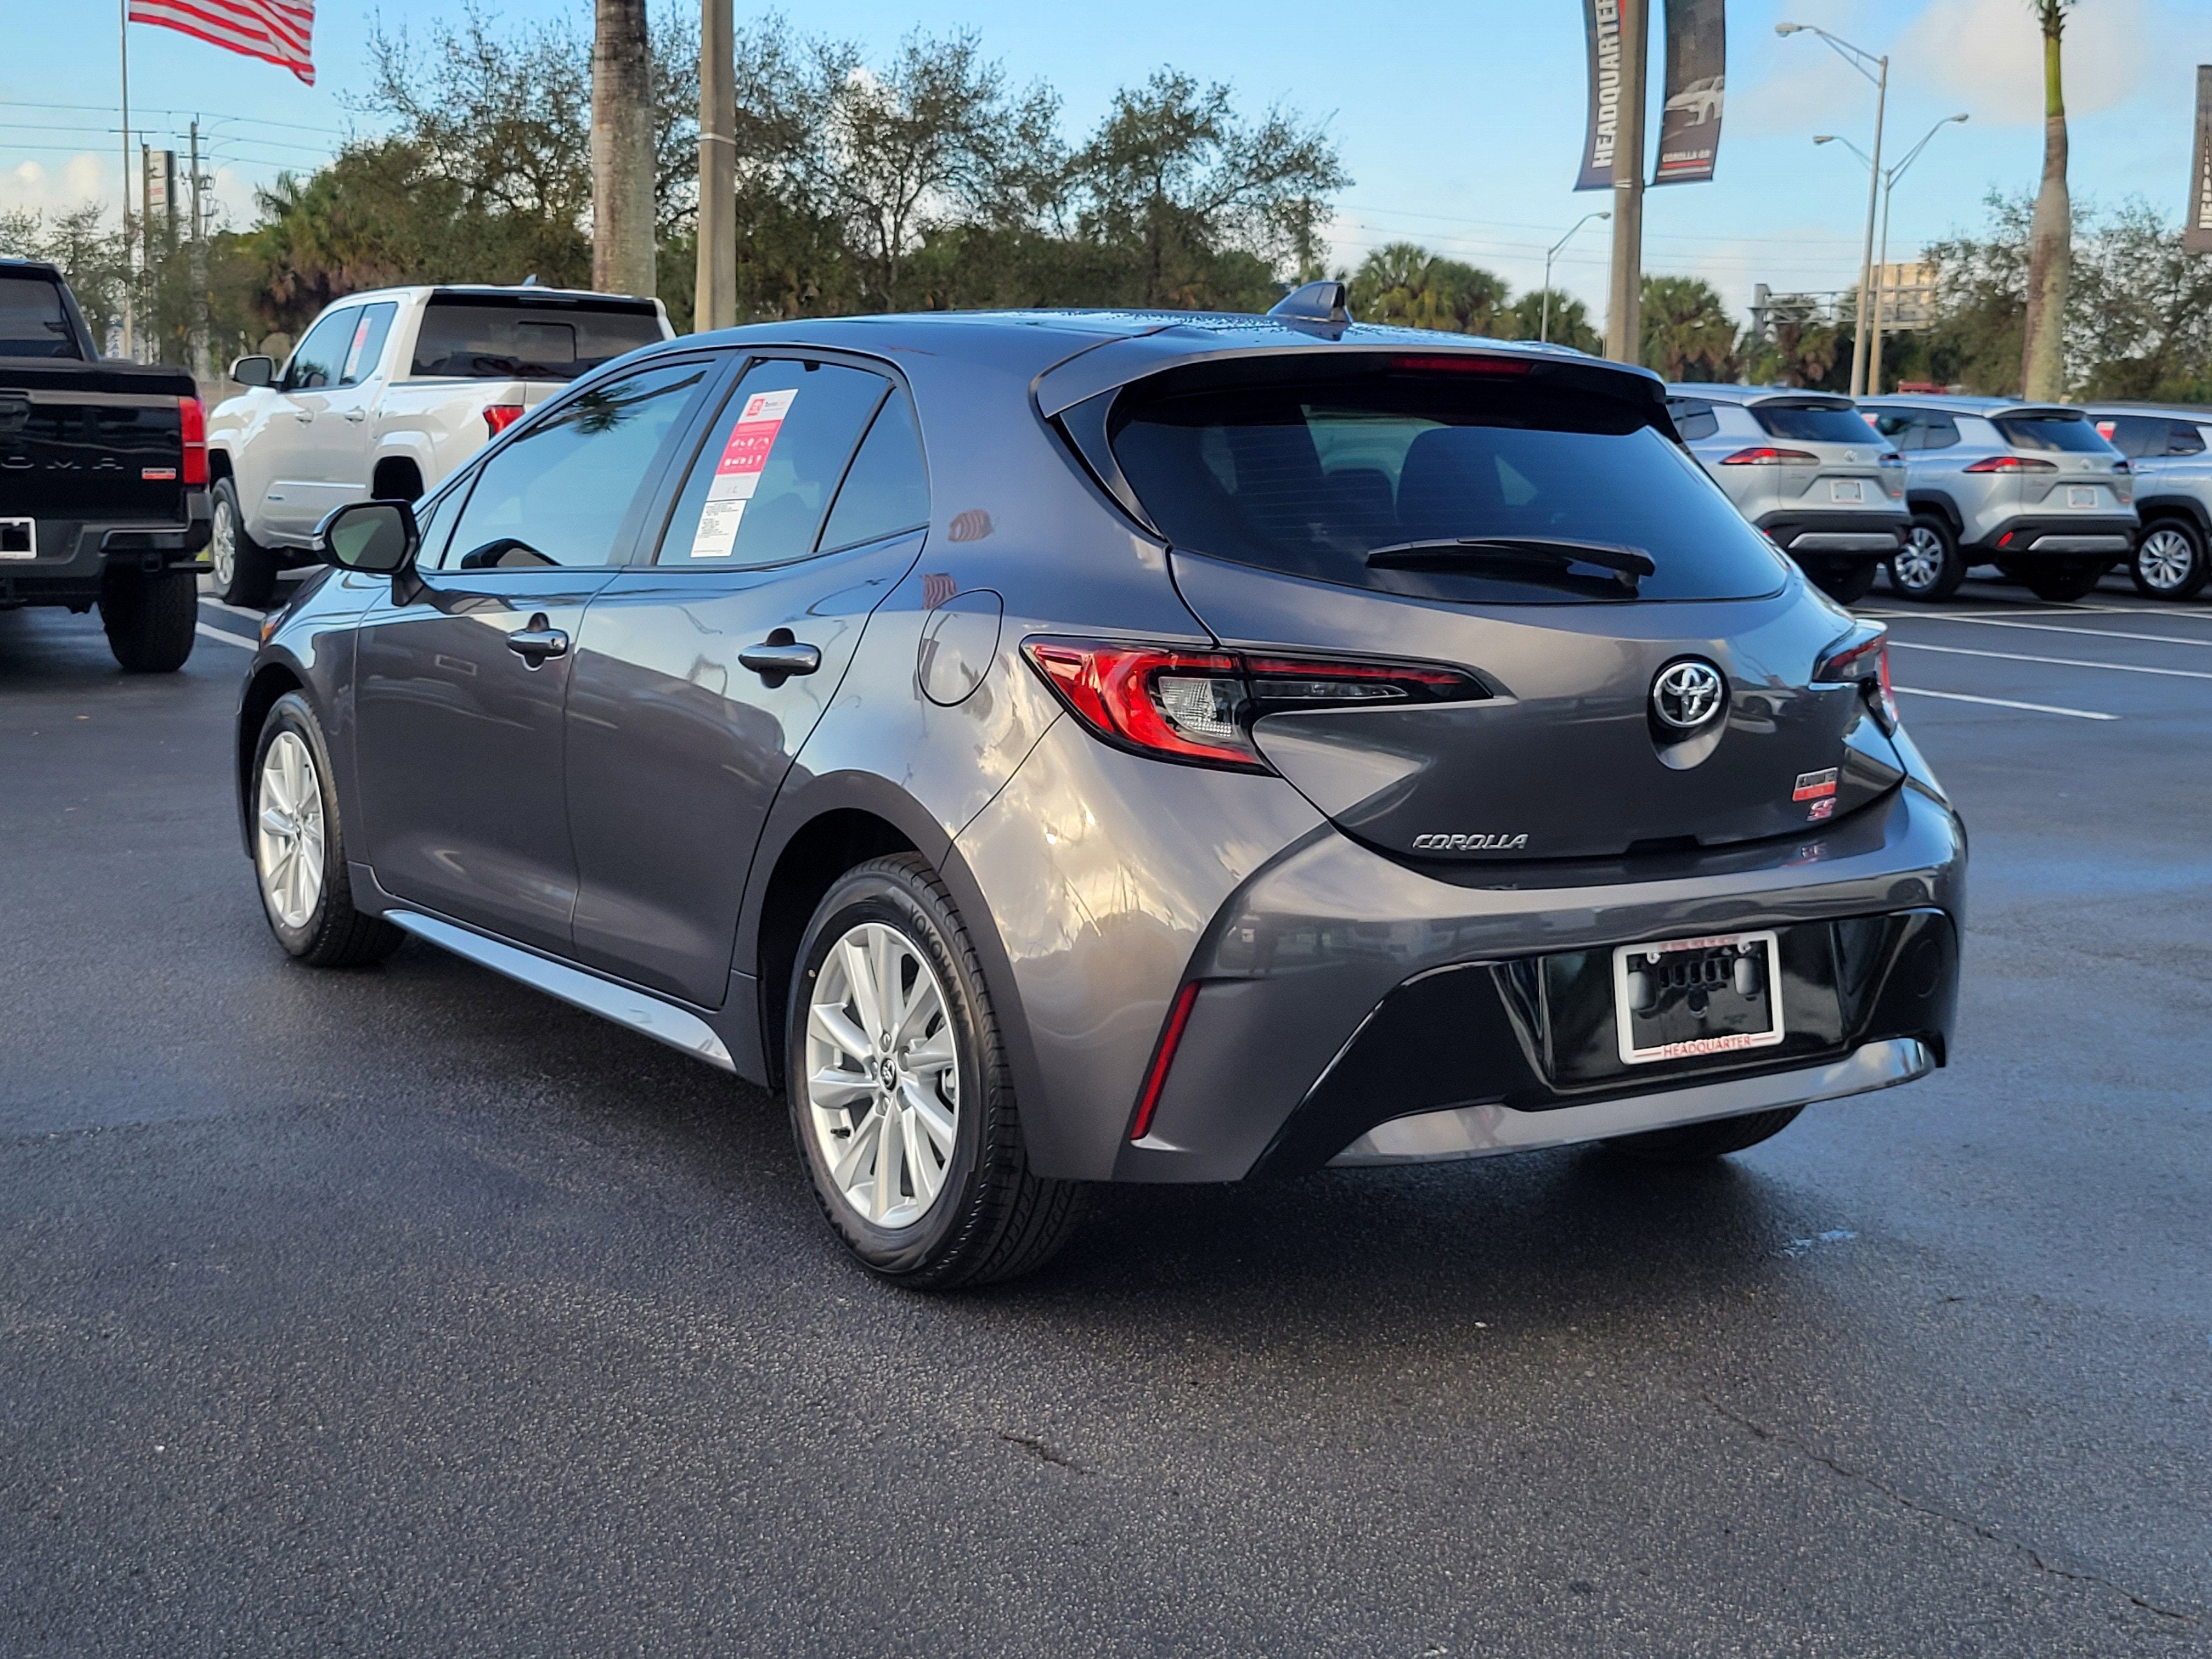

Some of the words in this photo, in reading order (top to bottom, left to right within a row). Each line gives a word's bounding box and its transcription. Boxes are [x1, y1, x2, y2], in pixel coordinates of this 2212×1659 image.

[1412, 833, 1529, 850] COROLLA
[909, 904, 970, 1034] YOKOHAMA
[1663, 1036, 1751, 1057] HEADQUARTER
